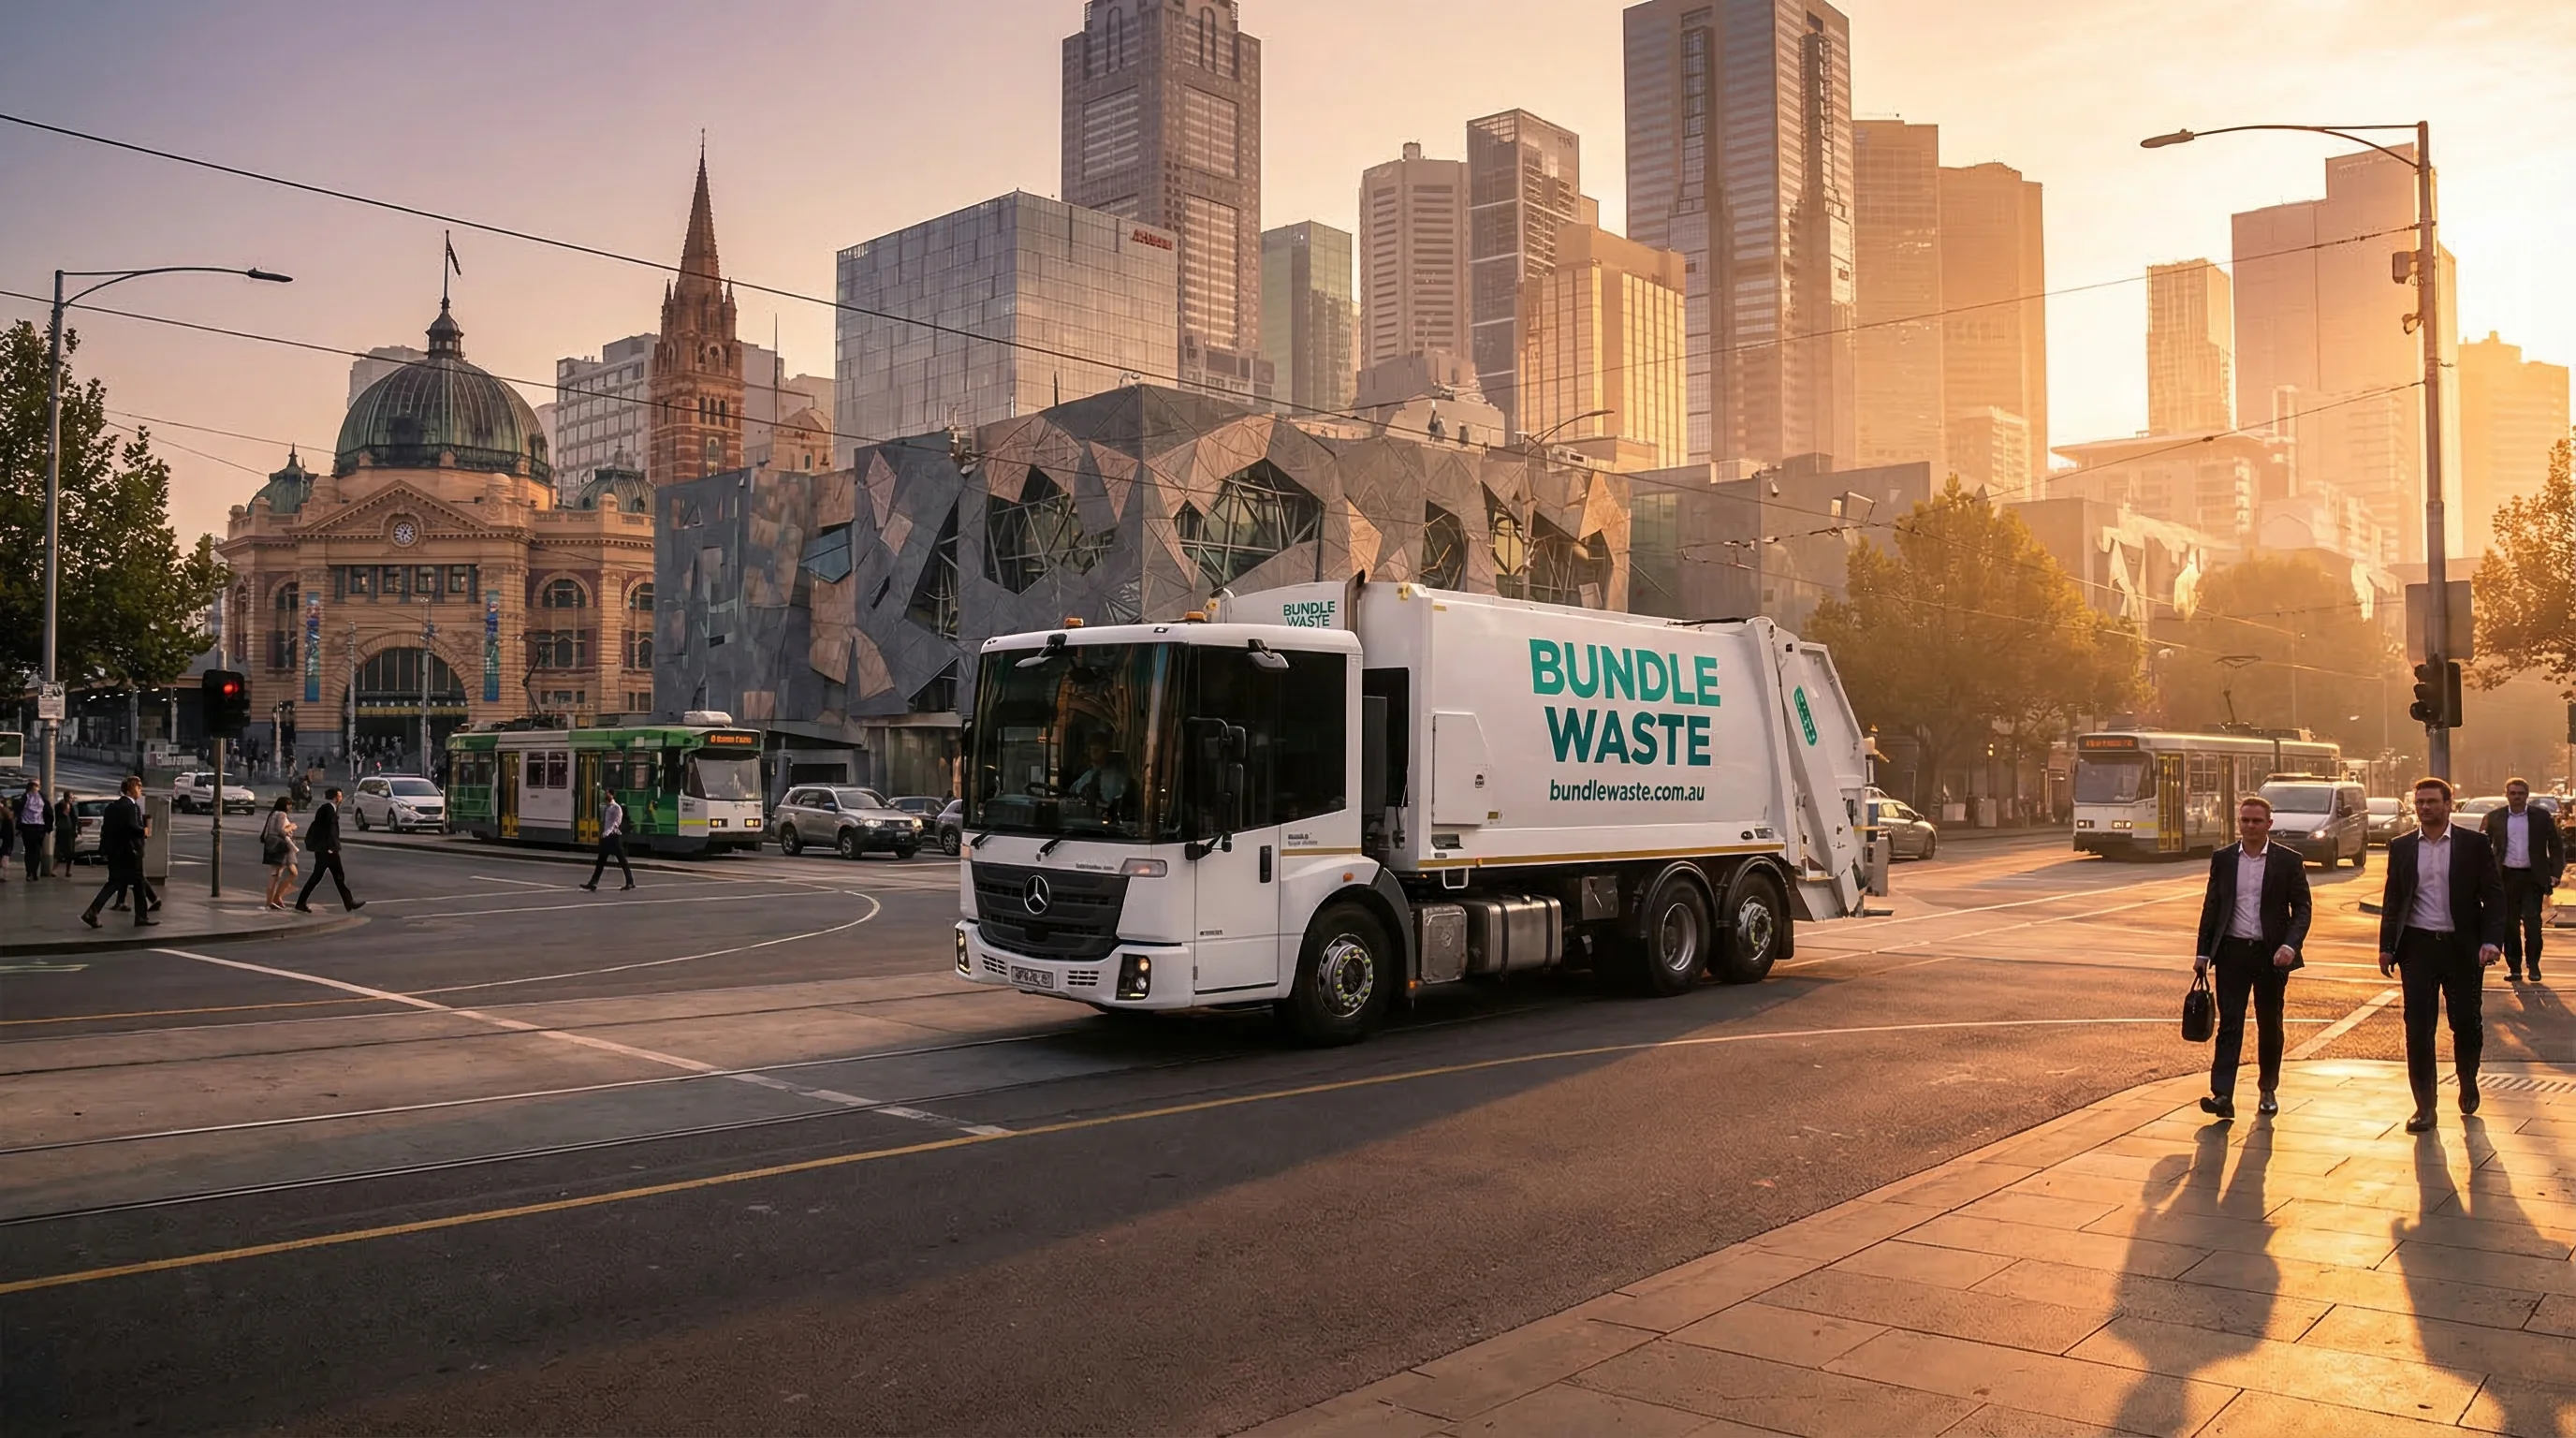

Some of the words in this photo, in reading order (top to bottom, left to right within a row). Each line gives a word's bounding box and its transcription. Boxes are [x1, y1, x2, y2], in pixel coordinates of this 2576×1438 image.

[1283, 600, 1335, 617] BUNDLE
[1286, 614, 1330, 628] WASTE
[1529, 638, 1721, 707] BUNDLE
[1544, 705, 1711, 767] WASTE
[1549, 779, 1705, 801] bundlewaste.com.au
